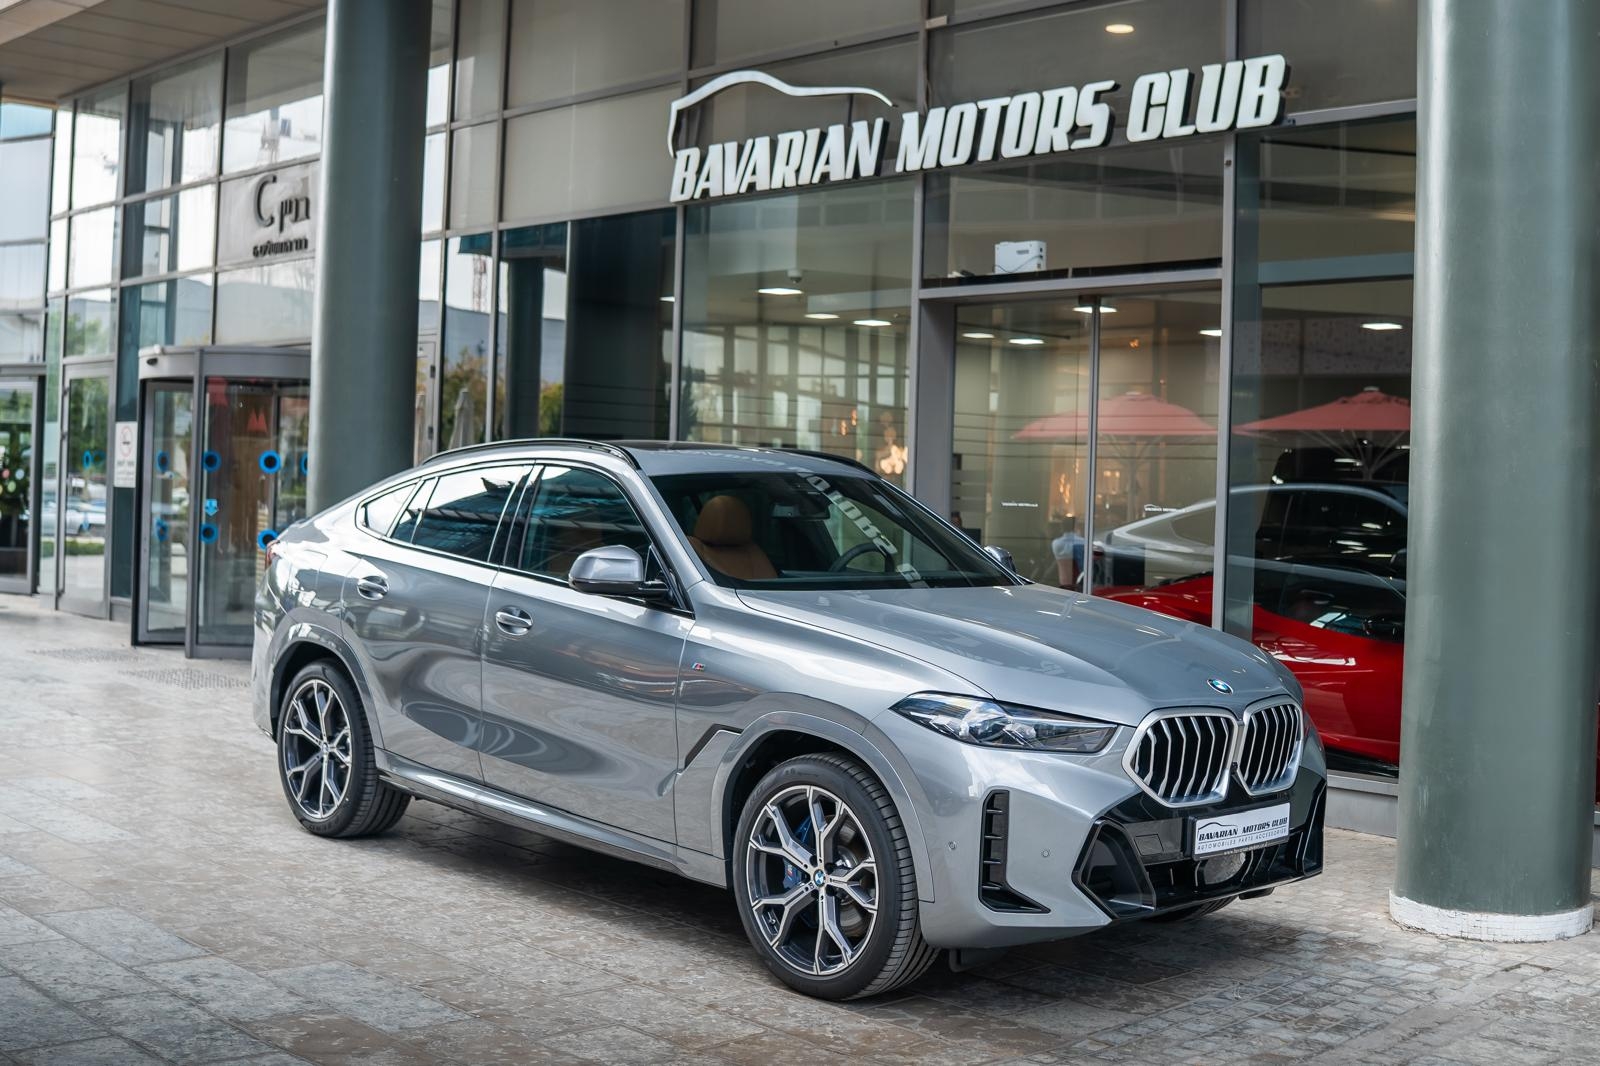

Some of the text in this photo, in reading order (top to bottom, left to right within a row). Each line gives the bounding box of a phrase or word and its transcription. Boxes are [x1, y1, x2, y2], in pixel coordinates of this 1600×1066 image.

[670, 53, 1288, 203] BAVARIAN MOTORS CLUB
[253, 173, 277, 228] C
[1197, 839, 1236, 851] AUTOMOBILES
[1198, 817, 1288, 841] BAVARIAN MOTORS CLUB
